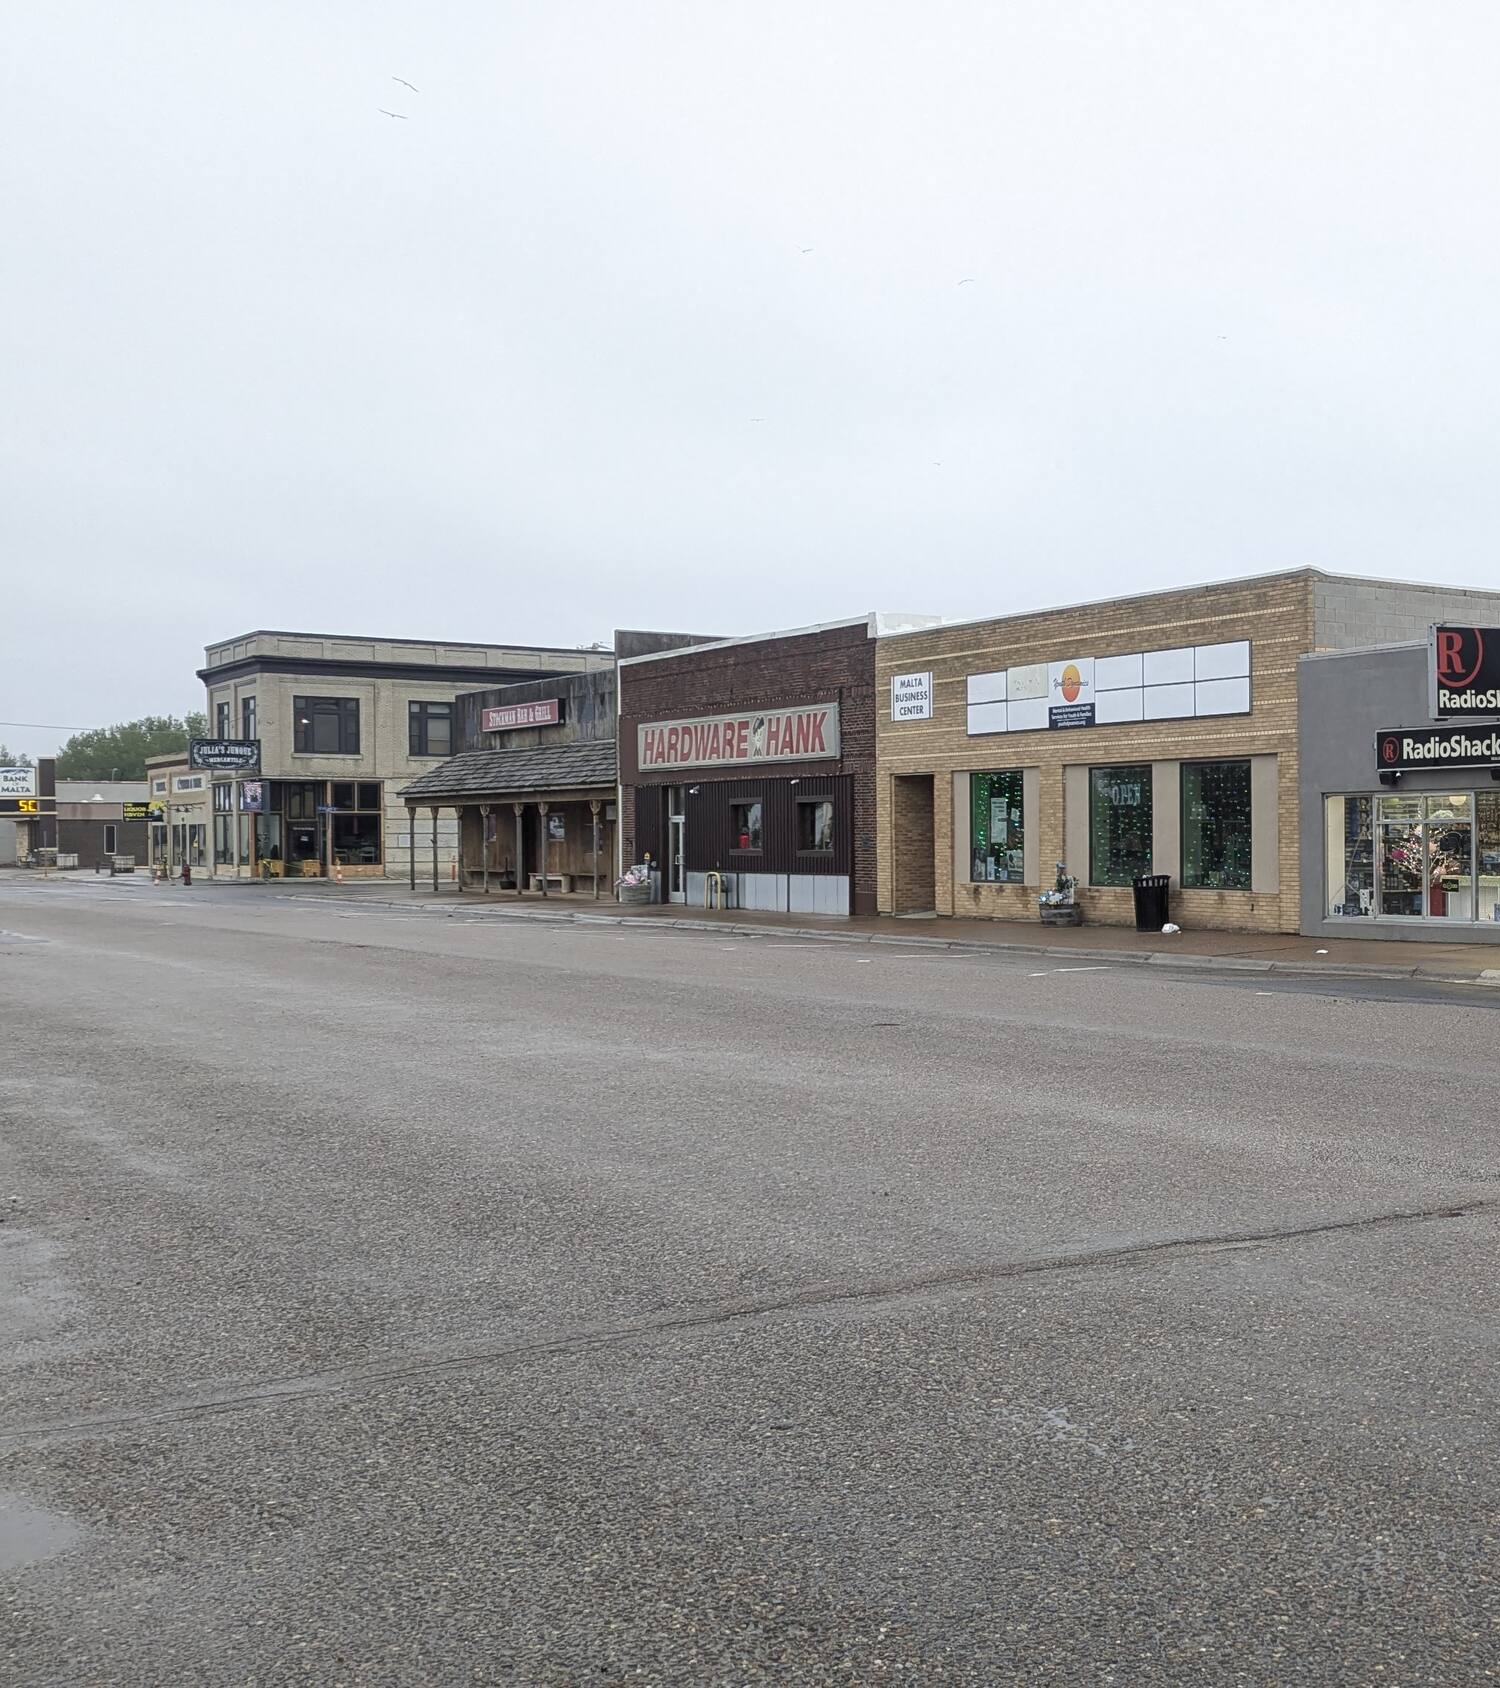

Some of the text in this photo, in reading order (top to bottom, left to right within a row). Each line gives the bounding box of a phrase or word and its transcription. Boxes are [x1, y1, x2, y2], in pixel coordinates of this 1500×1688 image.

[1437, 632, 1466, 673] R
[900, 677, 924, 689] MALTA
[895, 690, 928, 703] BUSINESS
[489, 711, 516, 727] STOCKMAN
[517, 708, 528, 723] BAR
[529, 708, 534, 721] &
[899, 704, 925, 716] CENTER
[642, 711, 828, 765] HARDWARE HANK
[1112, 783, 1141, 806] OPEN
